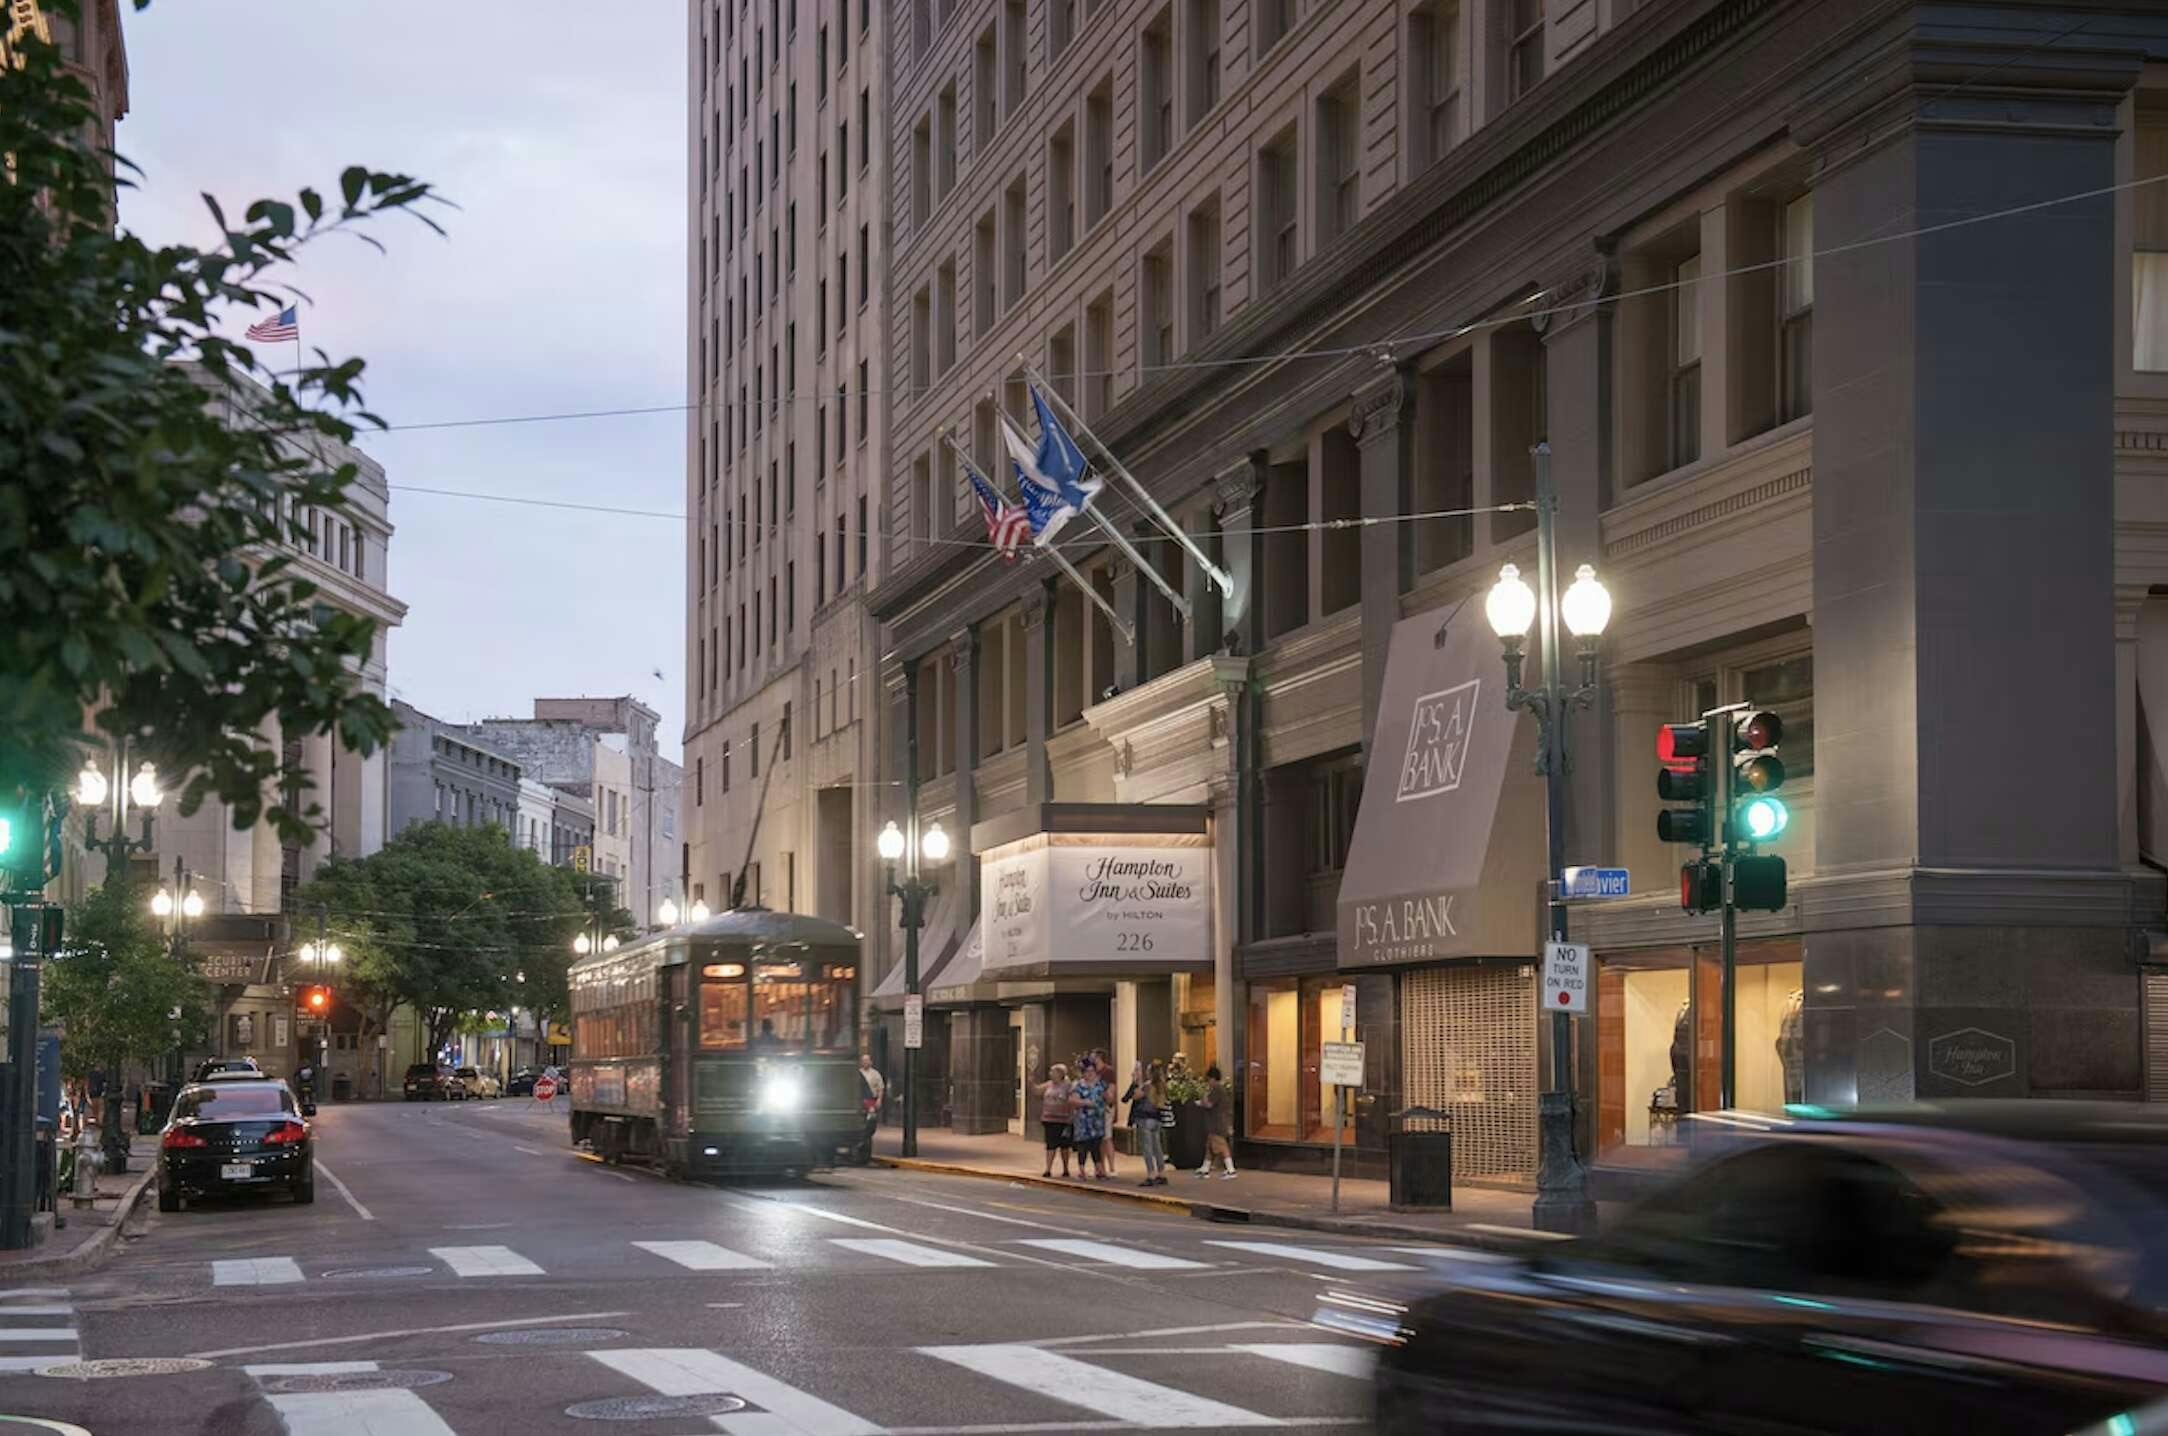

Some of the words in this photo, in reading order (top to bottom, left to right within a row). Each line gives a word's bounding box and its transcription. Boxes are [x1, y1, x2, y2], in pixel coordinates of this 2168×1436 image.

[1403, 741, 1461, 791] BANK
[1086, 856, 1183, 880] Hampton
[1080, 880, 1127, 902] Inn
[1140, 880, 1191, 900] Suites
[1122, 911, 1163, 920] HILTON
[1403, 895, 1457, 941] BANK
[1116, 932, 1154, 952] 226
[1556, 947, 1577, 962] NO
[206, 966, 251, 978] CENTER
[1553, 964, 1580, 976] TURN
[1547, 977, 1560, 988] ON
[1562, 978, 1585, 991] RED
